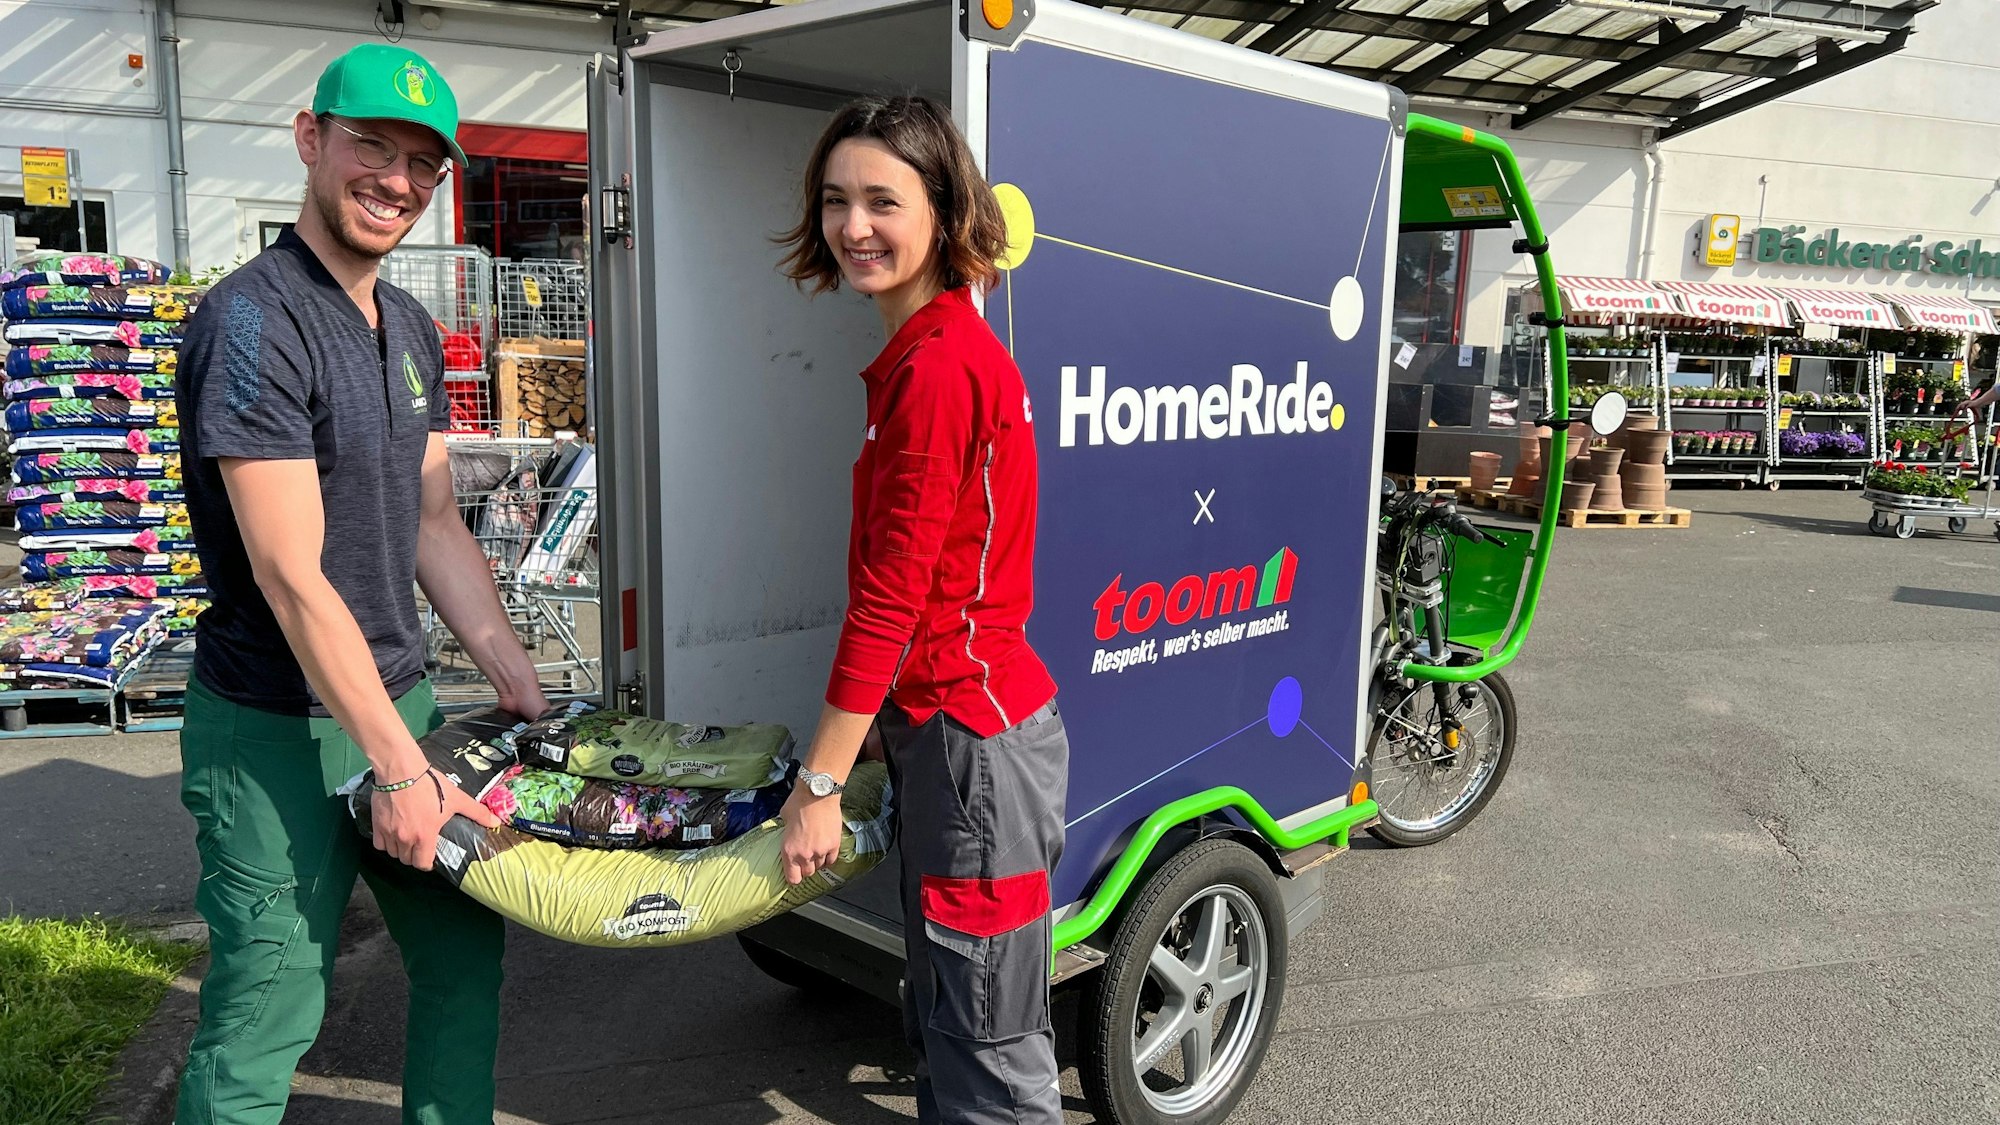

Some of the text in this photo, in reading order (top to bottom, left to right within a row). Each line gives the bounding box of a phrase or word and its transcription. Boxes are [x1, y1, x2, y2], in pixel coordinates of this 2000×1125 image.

[1757, 225, 1923, 271] Bäckerei
[1584, 294, 1645, 309] toom
[1697, 299, 1756, 318] toom
[1811, 304, 1866, 321] toom
[1920, 309, 1968, 325] toom
[1060, 361, 1345, 447] HomeRide.
[1093, 564, 1258, 641] toom
[1091, 609, 1290, 674] Respekt, wer's selber macht.
[682, 760, 715, 770] KRÄUTER
[530, 823, 571, 836] Blumenerde
[618, 922, 635, 933] BIO
